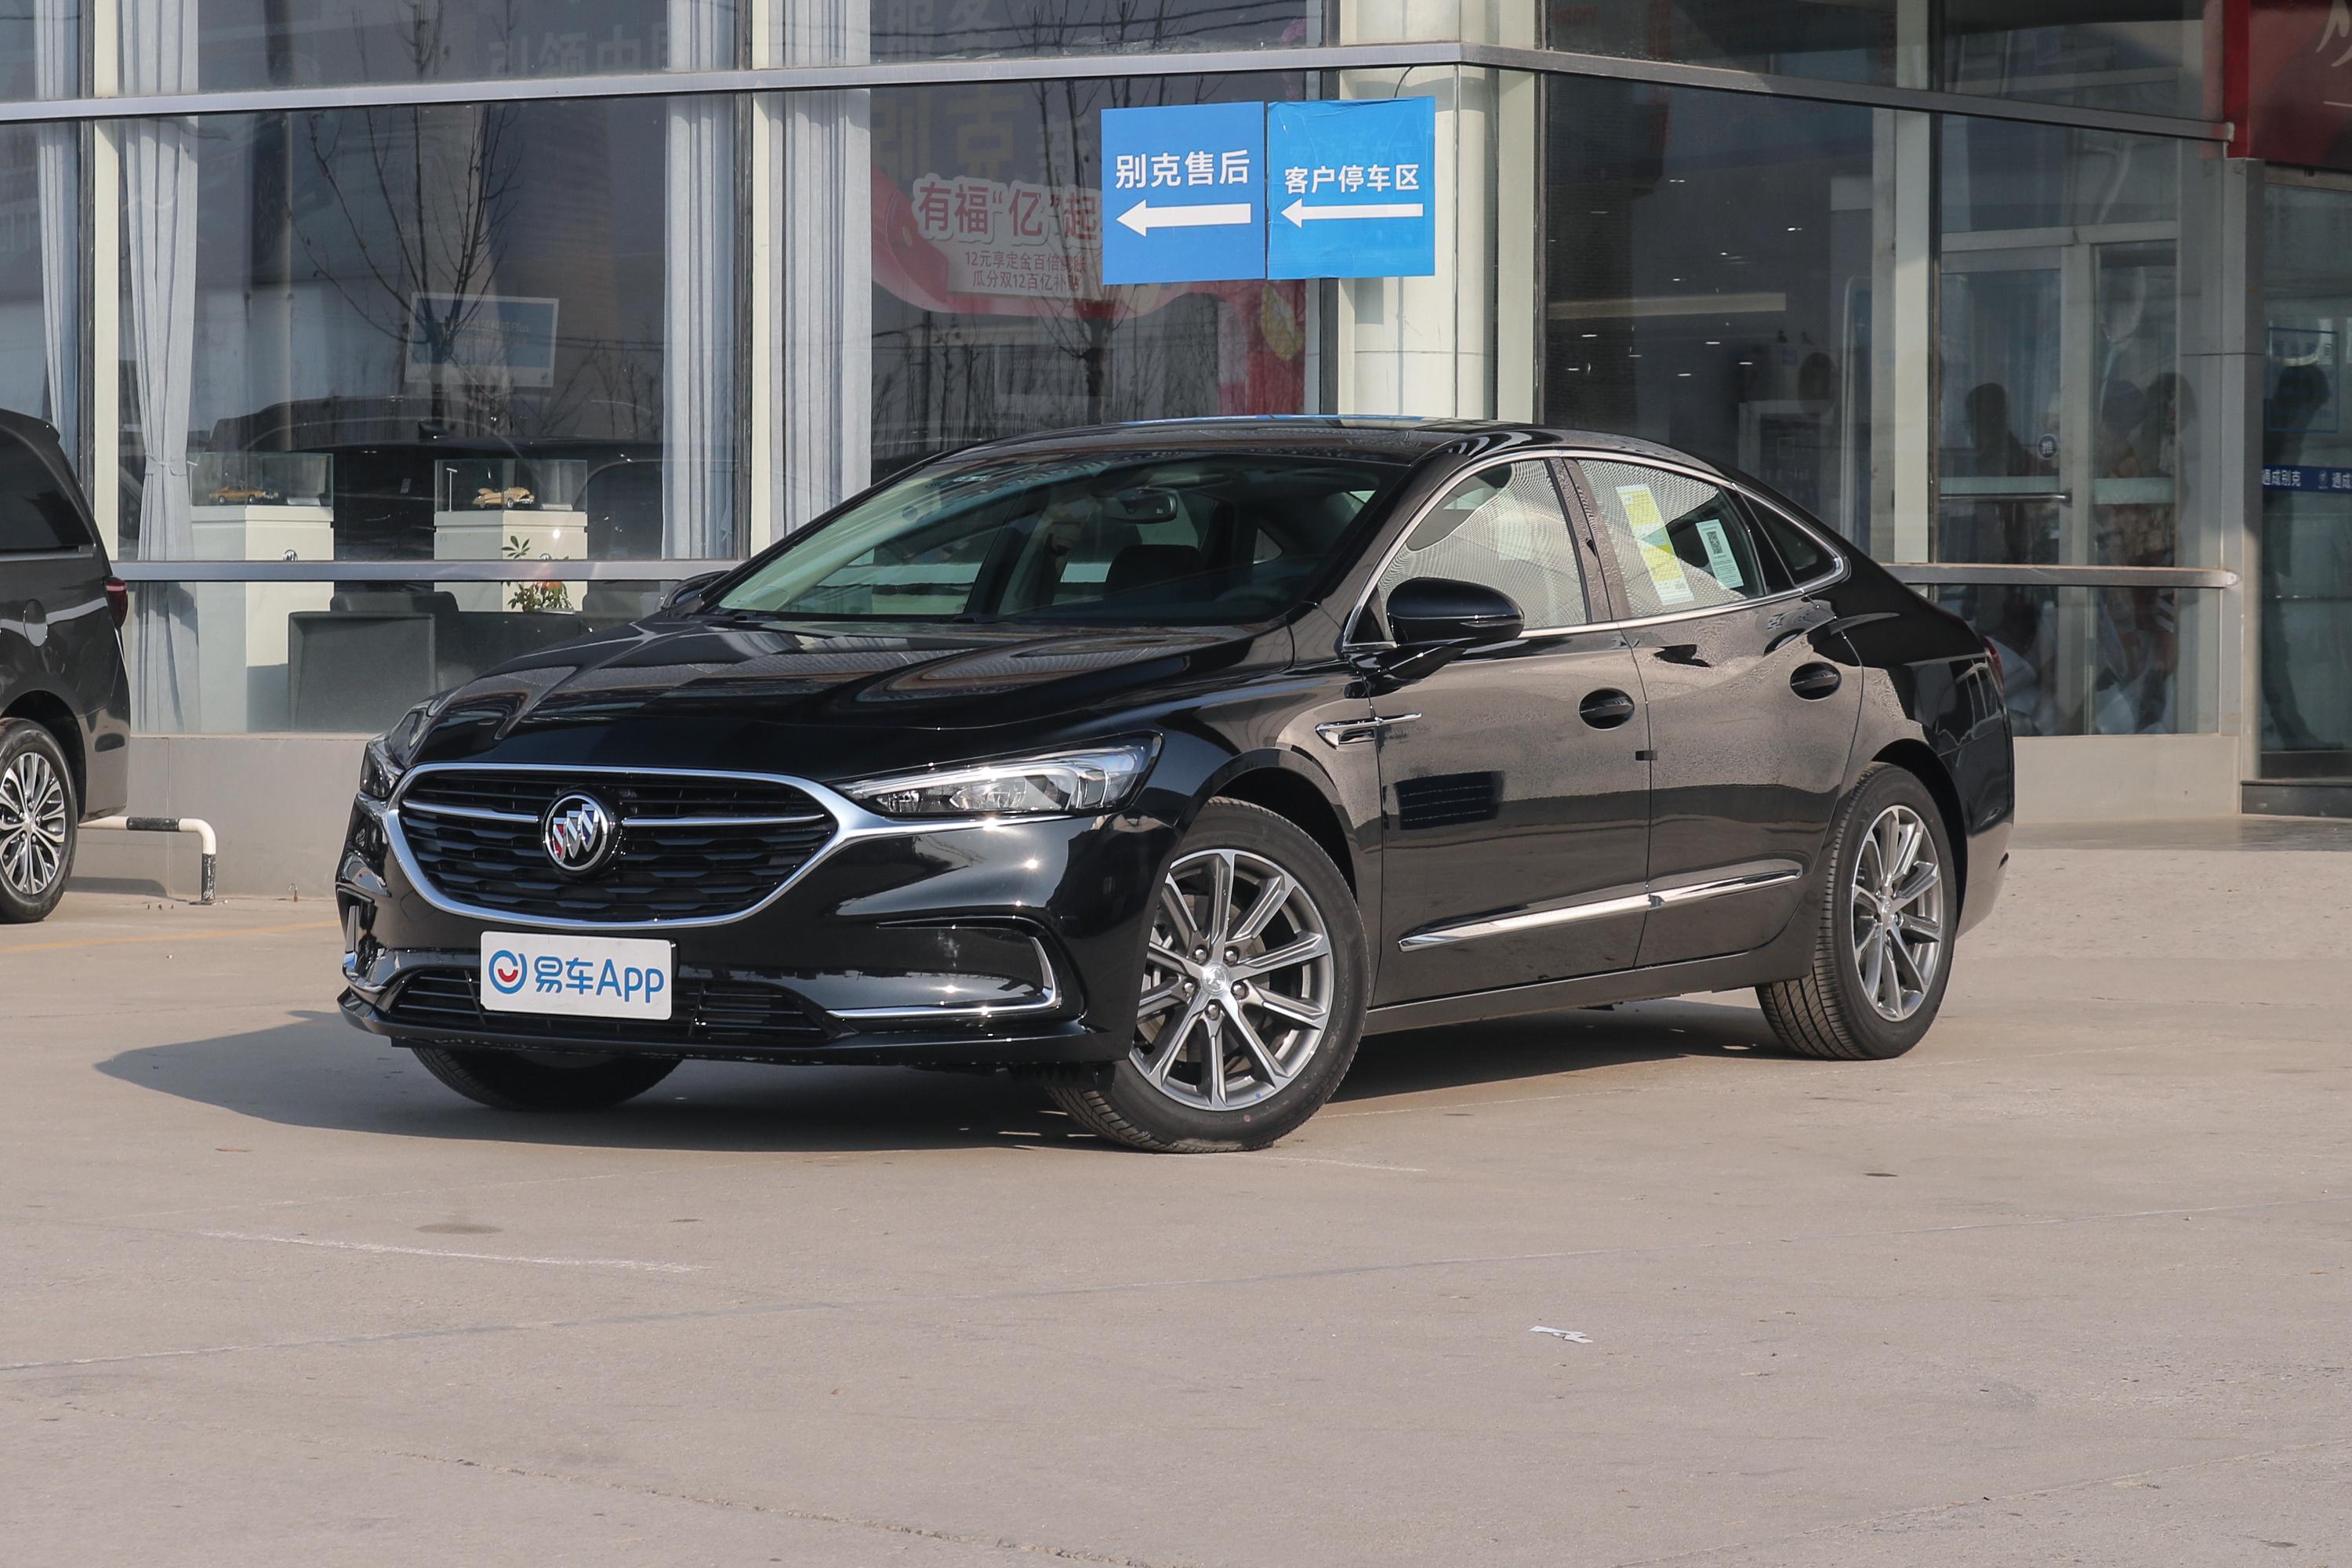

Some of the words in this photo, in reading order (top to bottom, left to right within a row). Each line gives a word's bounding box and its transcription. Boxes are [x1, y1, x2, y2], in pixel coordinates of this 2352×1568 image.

[1115, 149, 1250, 190] 别克售后
[1284, 164, 1420, 194] 客户停车区
[534, 956, 665, 1004] 易车App
